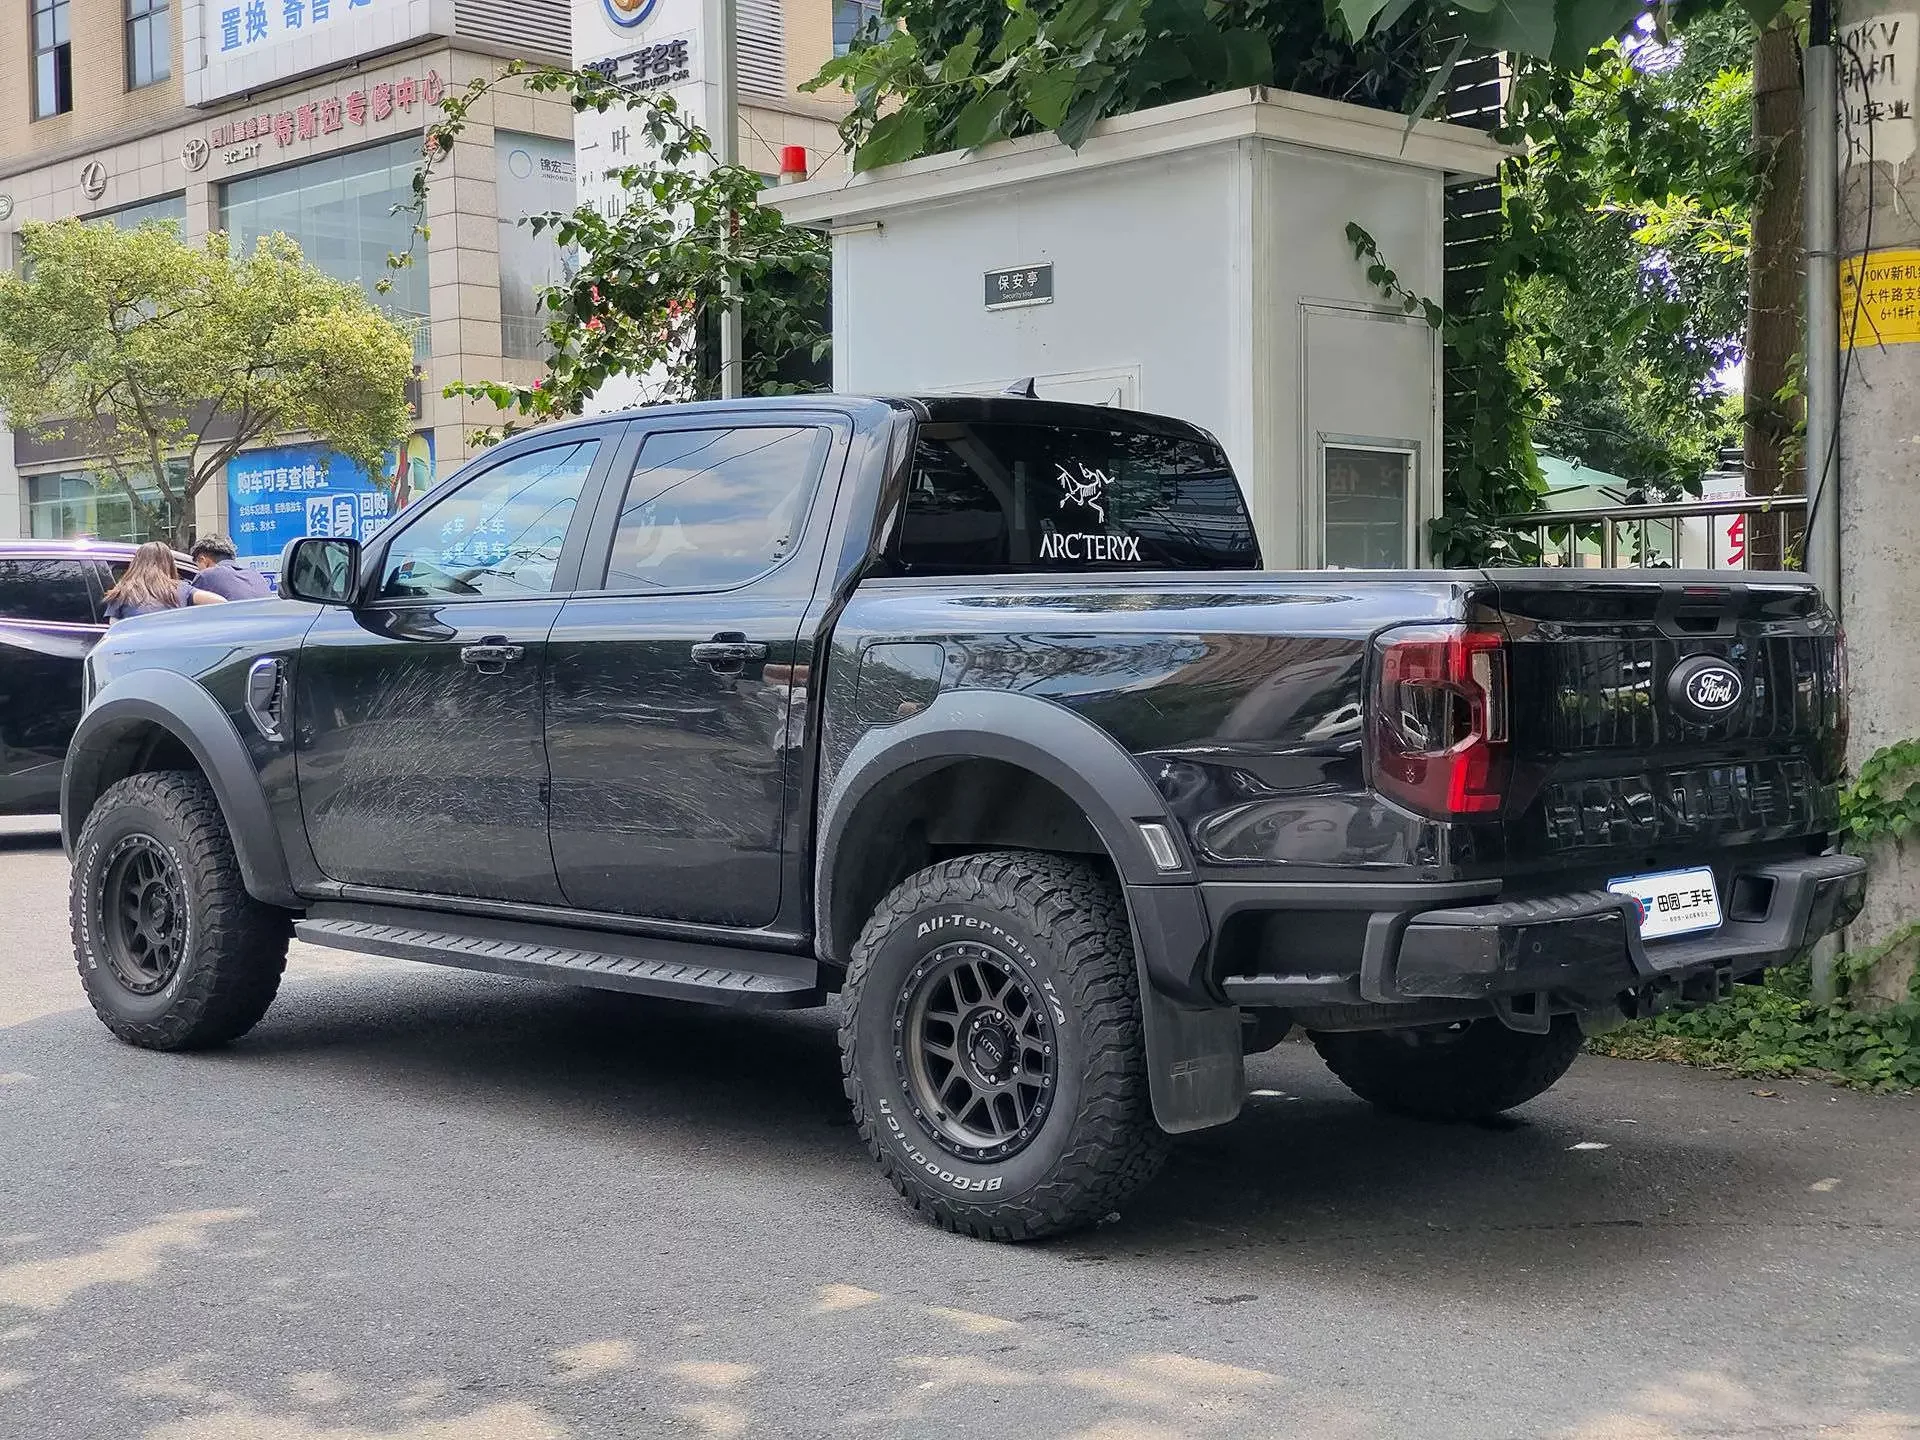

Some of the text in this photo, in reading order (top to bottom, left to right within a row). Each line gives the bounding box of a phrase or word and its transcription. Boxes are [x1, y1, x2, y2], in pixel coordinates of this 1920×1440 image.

[221, 1, 268, 51] 置换
[272, 69, 444, 147] 特斯拉专修中心
[998, 271, 1038, 291] 保安亭
[238, 464, 329, 495] 购车可享查博士
[360, 492, 389, 517] 回购
[1039, 533, 1142, 561] ARC'TERYX
[1698, 673, 1732, 703] Ford
[1657, 888, 1714, 913] 田园二手车
[917, 914, 1066, 1025] All-Terrain T/A
[879, 1098, 1004, 1192] BFGoodrich
